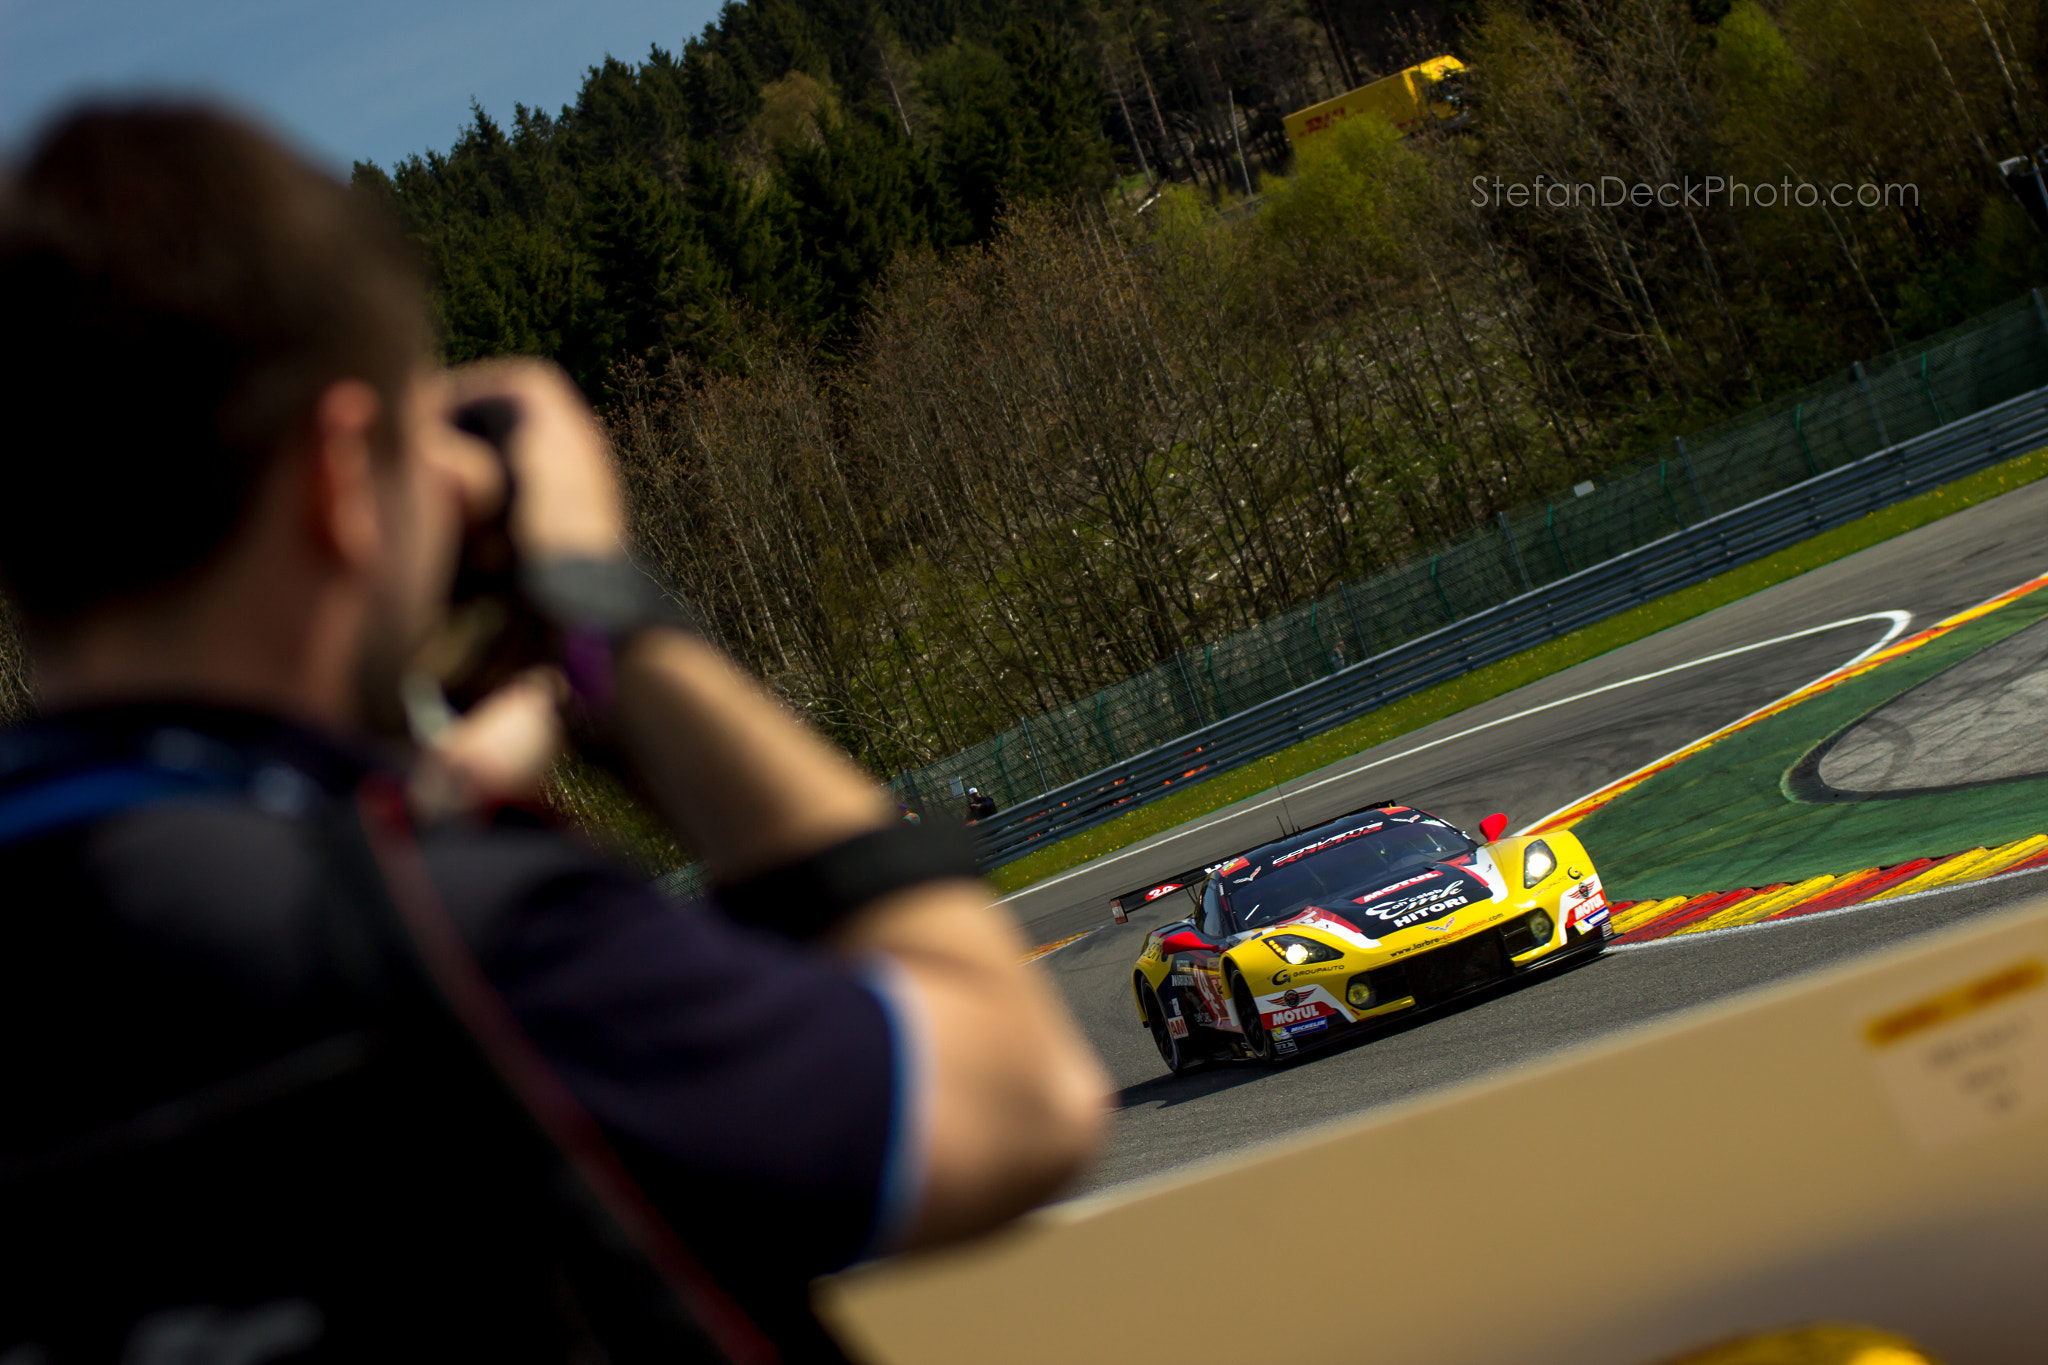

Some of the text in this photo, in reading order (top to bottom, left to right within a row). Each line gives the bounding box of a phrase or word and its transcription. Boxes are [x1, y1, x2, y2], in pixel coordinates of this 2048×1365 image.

[1363, 871, 1439, 903] MOTUL
[1393, 896, 1469, 928] HITORI
[1574, 893, 1605, 920] MOTUL
[1293, 964, 1345, 978] GROUPAUTO
[1272, 1004, 1319, 1026] MOTUL
[1170, 1018, 1188, 1036] AM
[1291, 1020, 1326, 1033] MICHELIN
